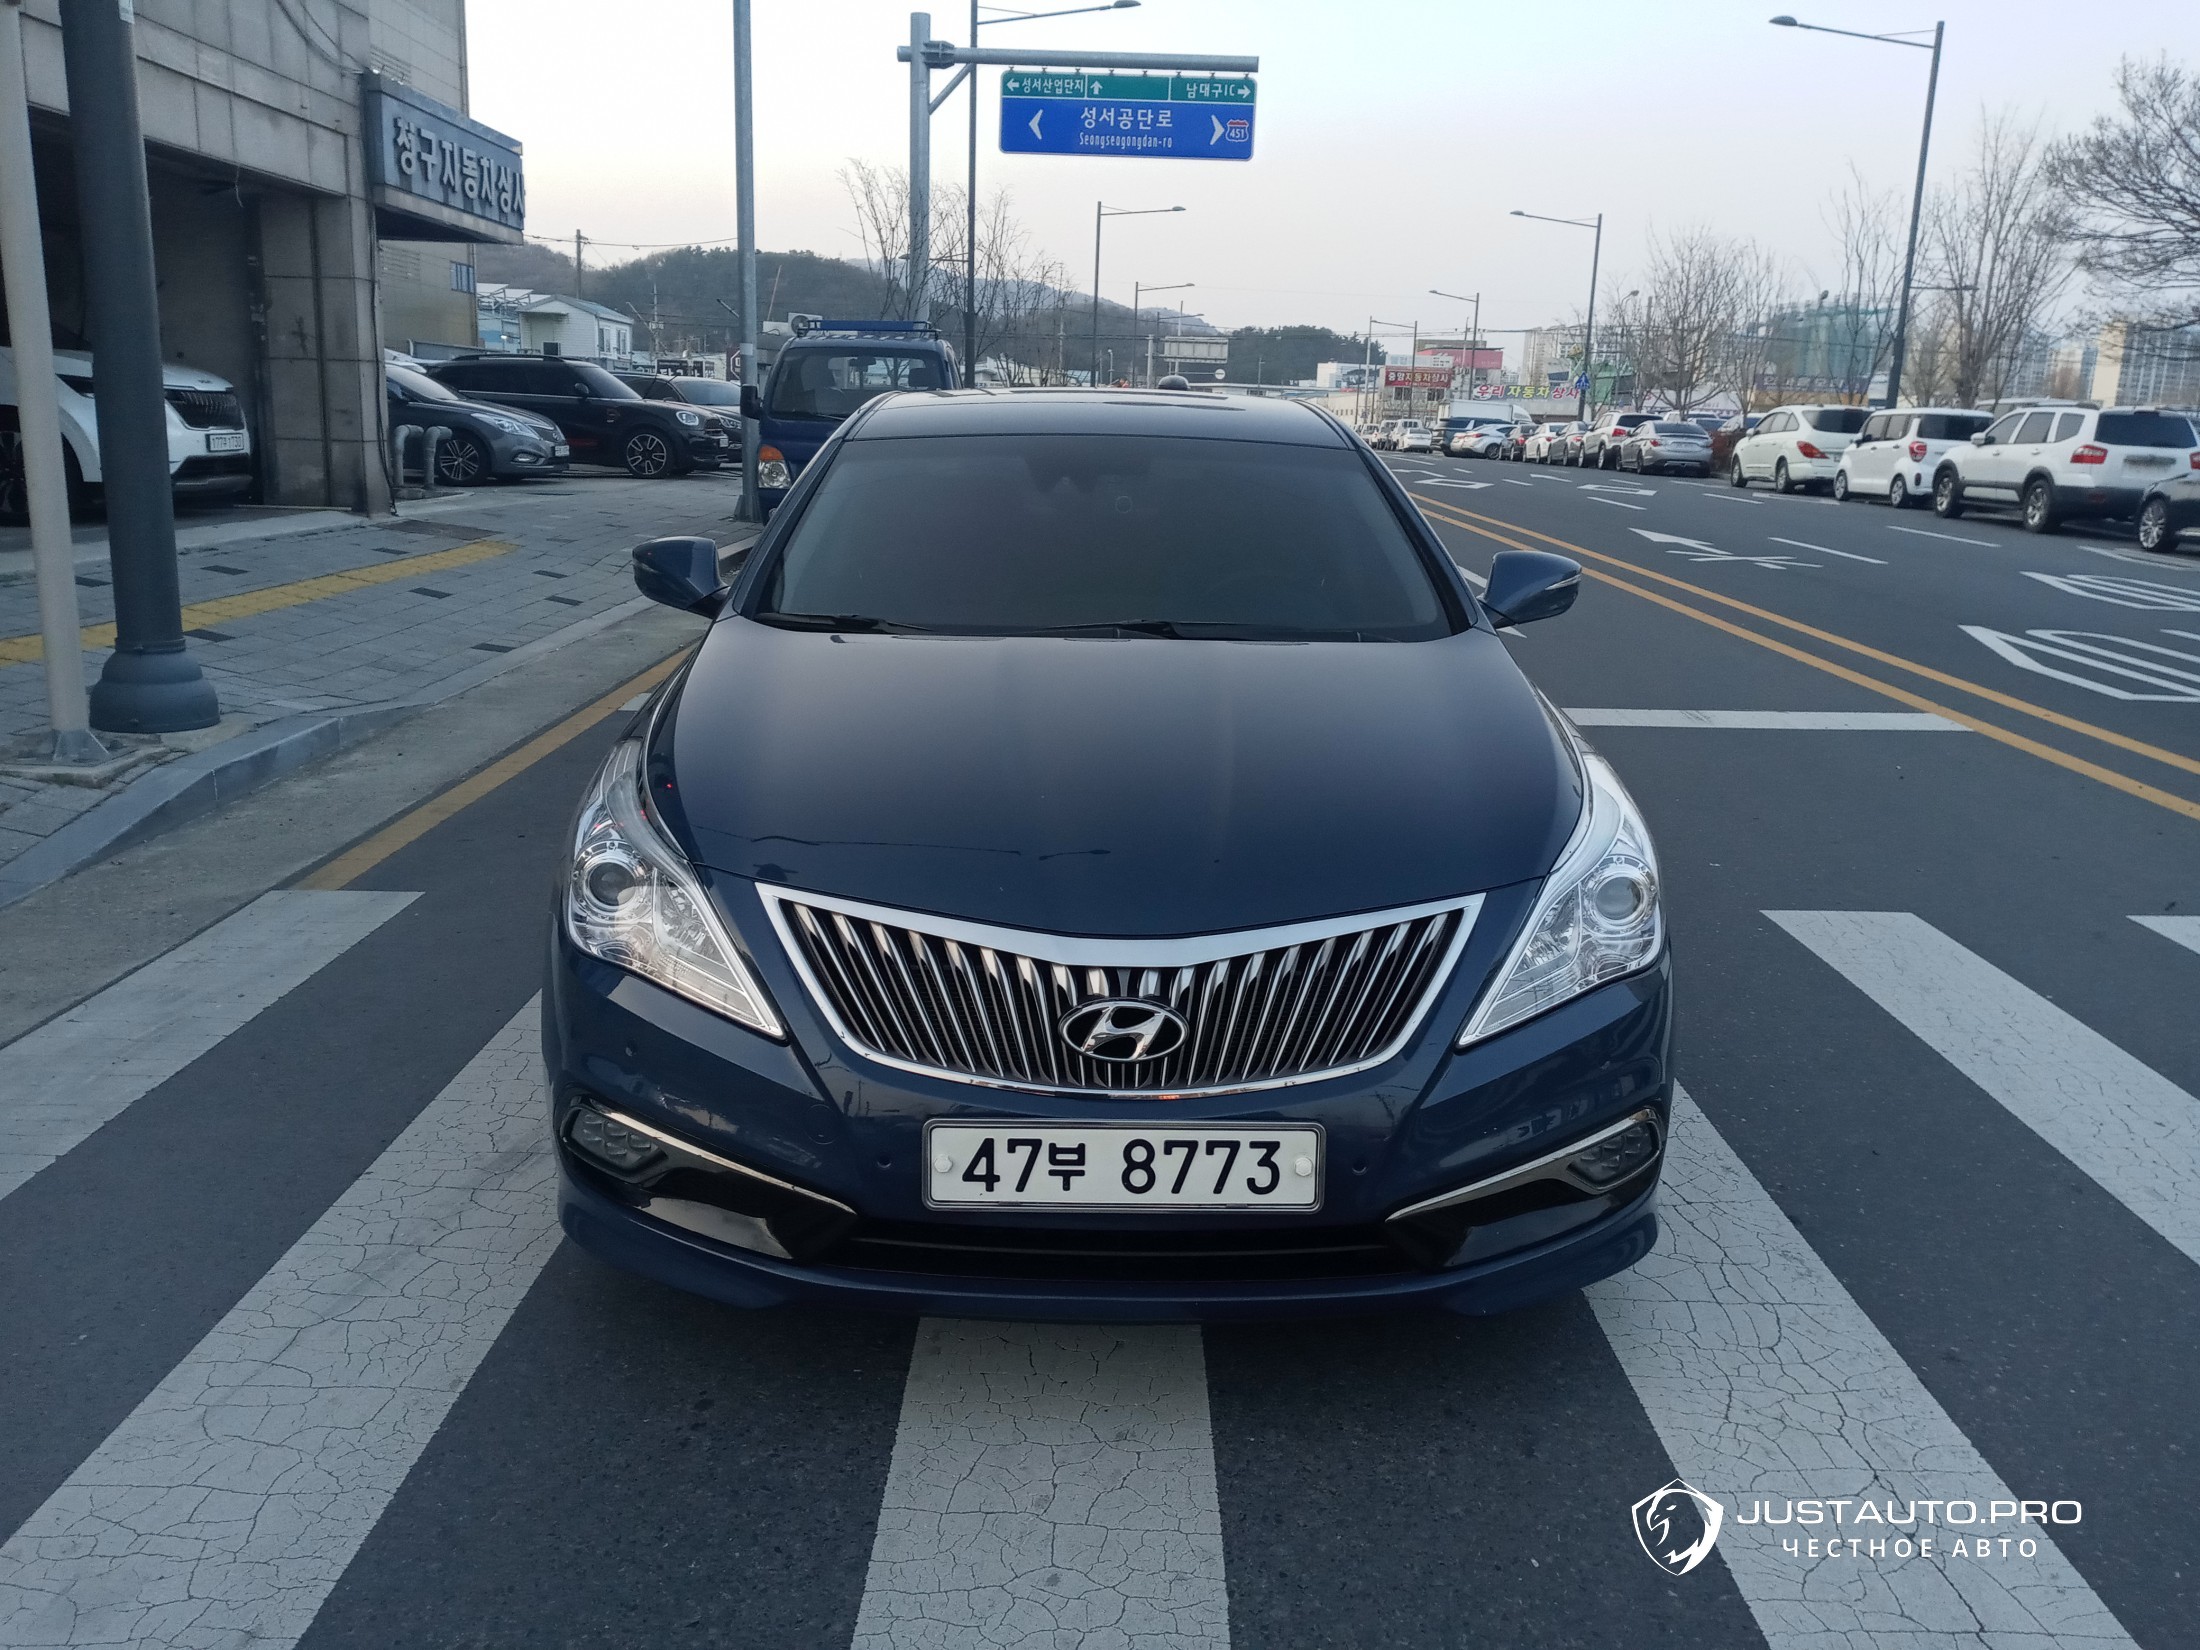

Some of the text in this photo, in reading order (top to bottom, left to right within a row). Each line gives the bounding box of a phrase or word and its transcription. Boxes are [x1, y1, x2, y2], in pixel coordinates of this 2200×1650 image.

[1022, 78, 1084, 94] 성서산업단지
[1186, 83, 1235, 99] 남대구IC
[1080, 106, 1173, 130] 성서공단로
[1079, 132, 1173, 150] Seongseogongdan-ro
[1229, 128, 1245, 139] 451
[395, 117, 526, 217] 청구자동차상사
[961, 1137, 1281, 1195] 47부 8773
